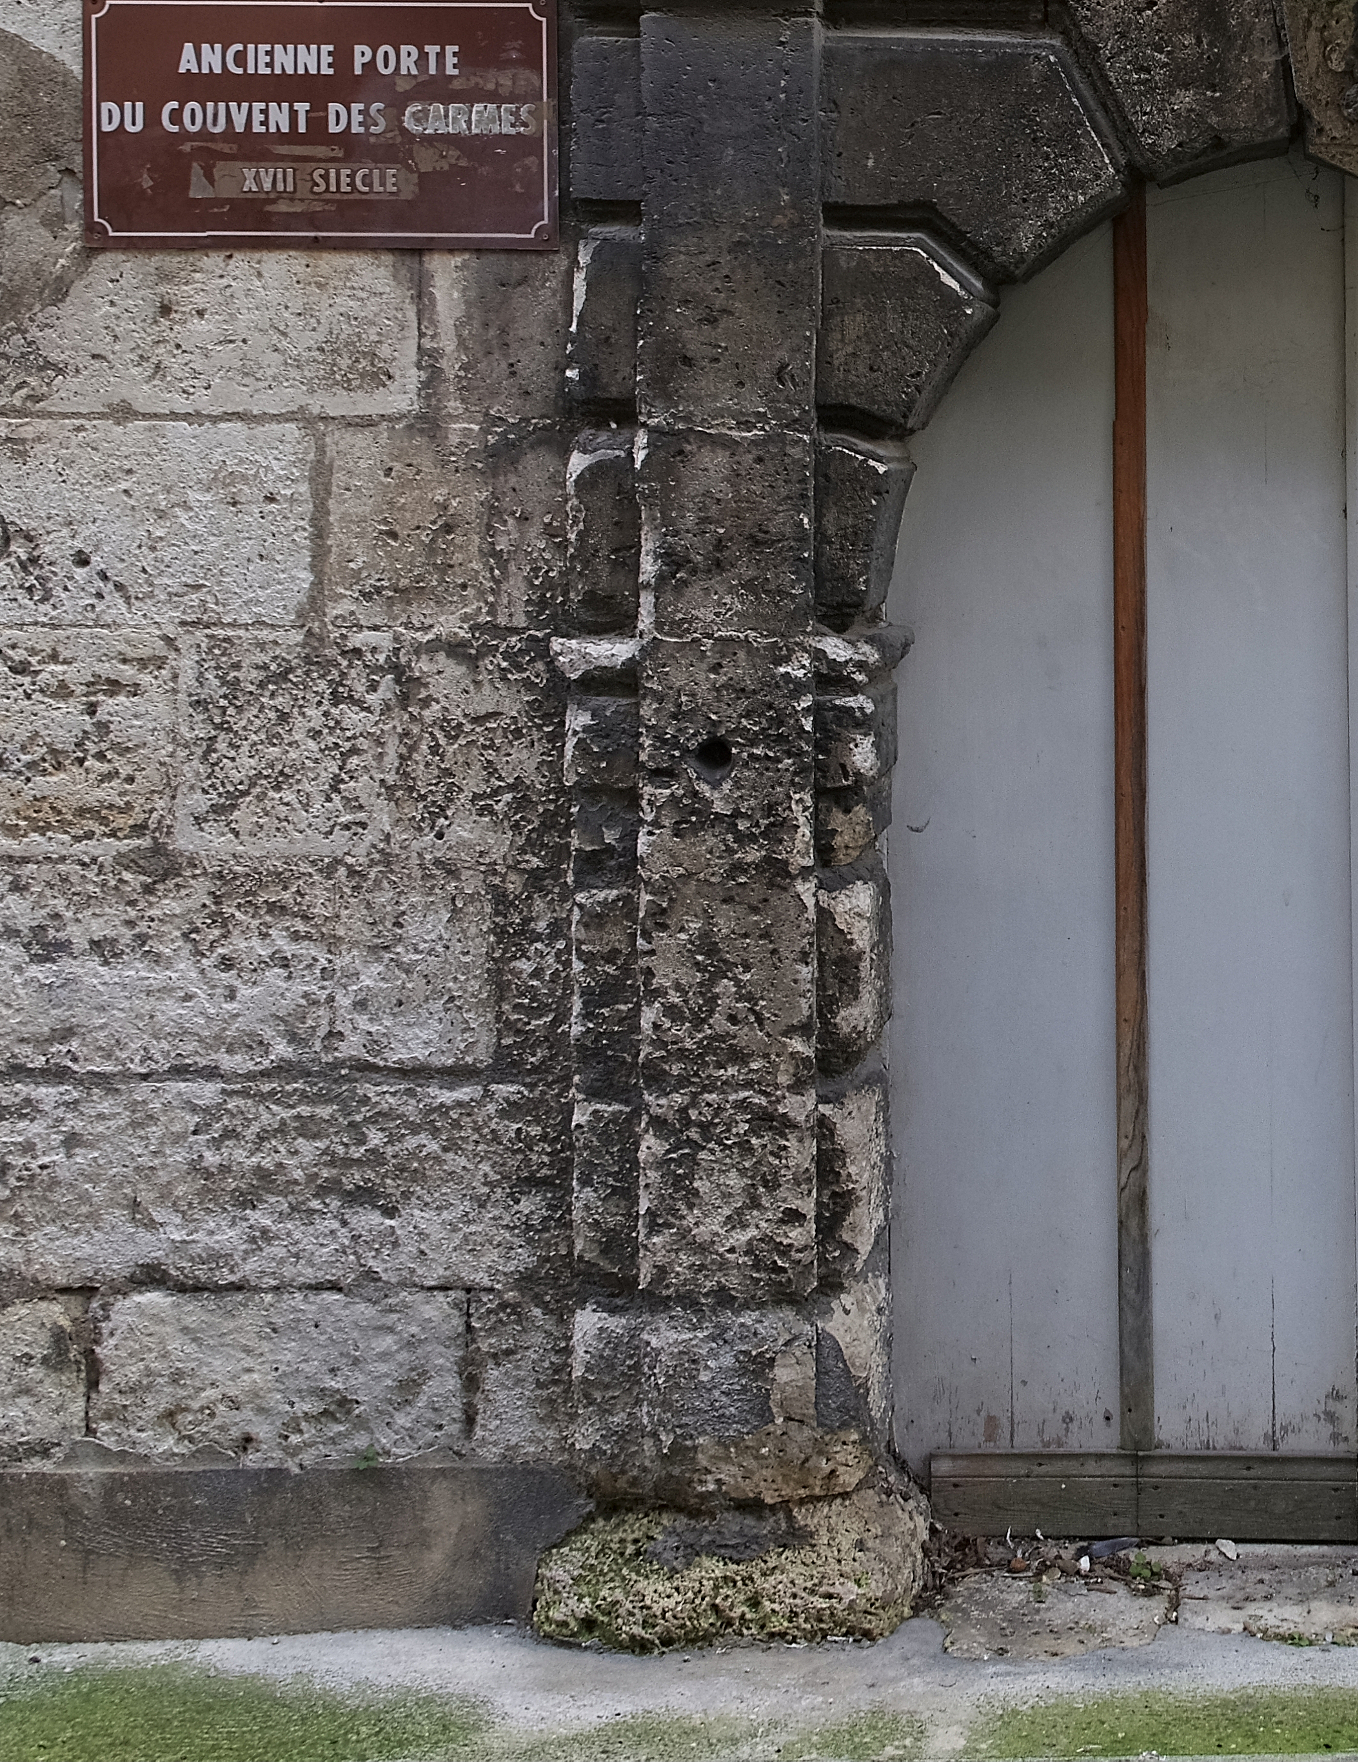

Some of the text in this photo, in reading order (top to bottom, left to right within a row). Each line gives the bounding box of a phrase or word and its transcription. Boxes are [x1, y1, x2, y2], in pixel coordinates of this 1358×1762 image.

[178, 42, 460, 75] ANCIENNE PORTE
[101, 101, 537, 135] DU COUVENT DES CARMES
[242, 168, 398, 193] XVII SIECLE
